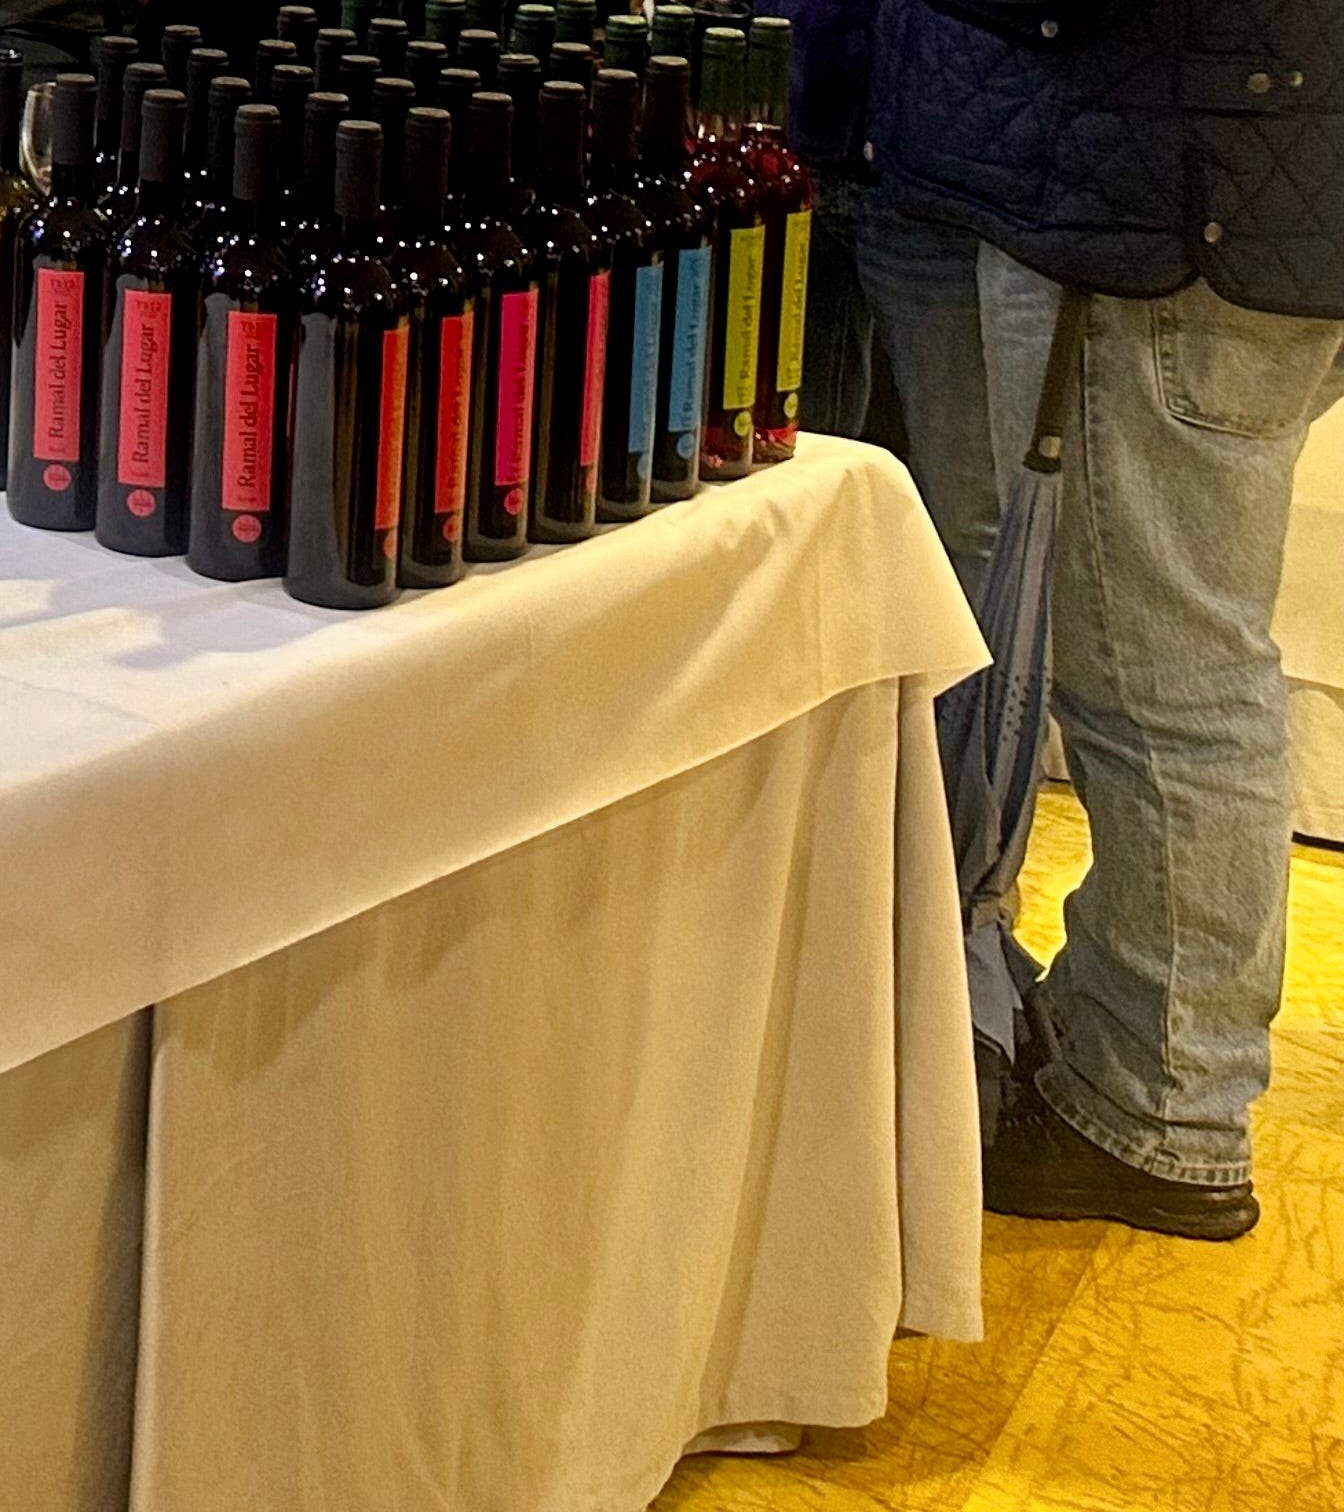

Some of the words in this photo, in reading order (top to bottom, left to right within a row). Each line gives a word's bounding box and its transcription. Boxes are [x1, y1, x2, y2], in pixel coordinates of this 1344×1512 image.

[52, 302, 71, 351] Lugar
[136, 323, 157, 374] Lugar
[50, 355, 66, 380] del
[134, 378, 151, 404] del
[239, 343, 264, 397] Lugar
[48, 384, 65, 439] Ramal
[132, 408, 150, 463] Ramal
[239, 401, 258, 427] del
[237, 431, 256, 488] Ramal
